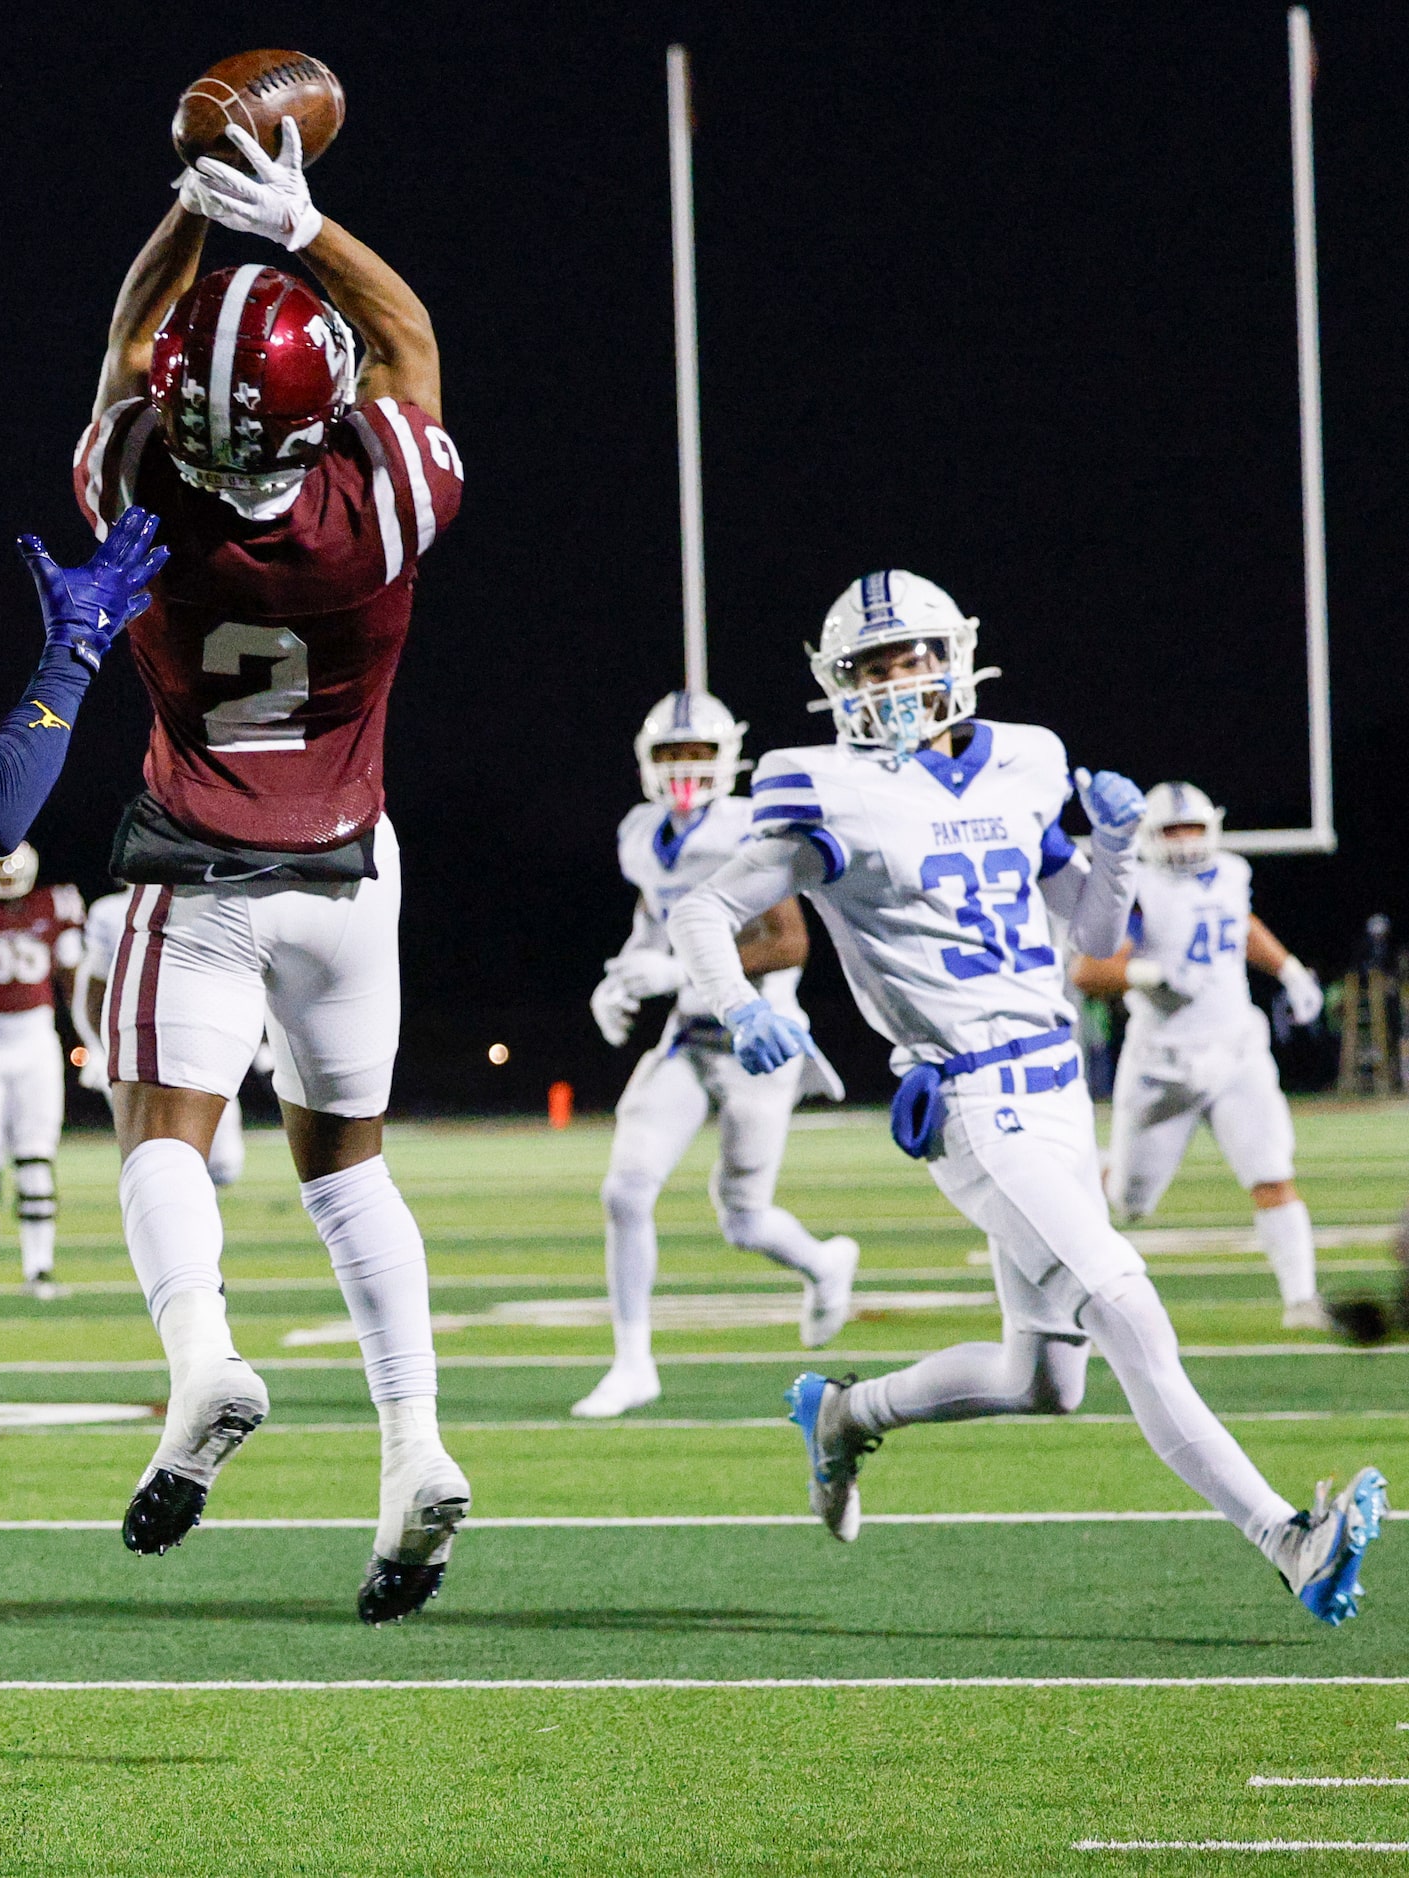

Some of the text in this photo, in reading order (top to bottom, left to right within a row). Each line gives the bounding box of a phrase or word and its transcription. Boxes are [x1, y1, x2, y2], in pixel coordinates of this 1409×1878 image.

[202, 621, 309, 753] 2
[932, 817, 1009, 846] PANTHERS
[920, 847, 1055, 981] 32
